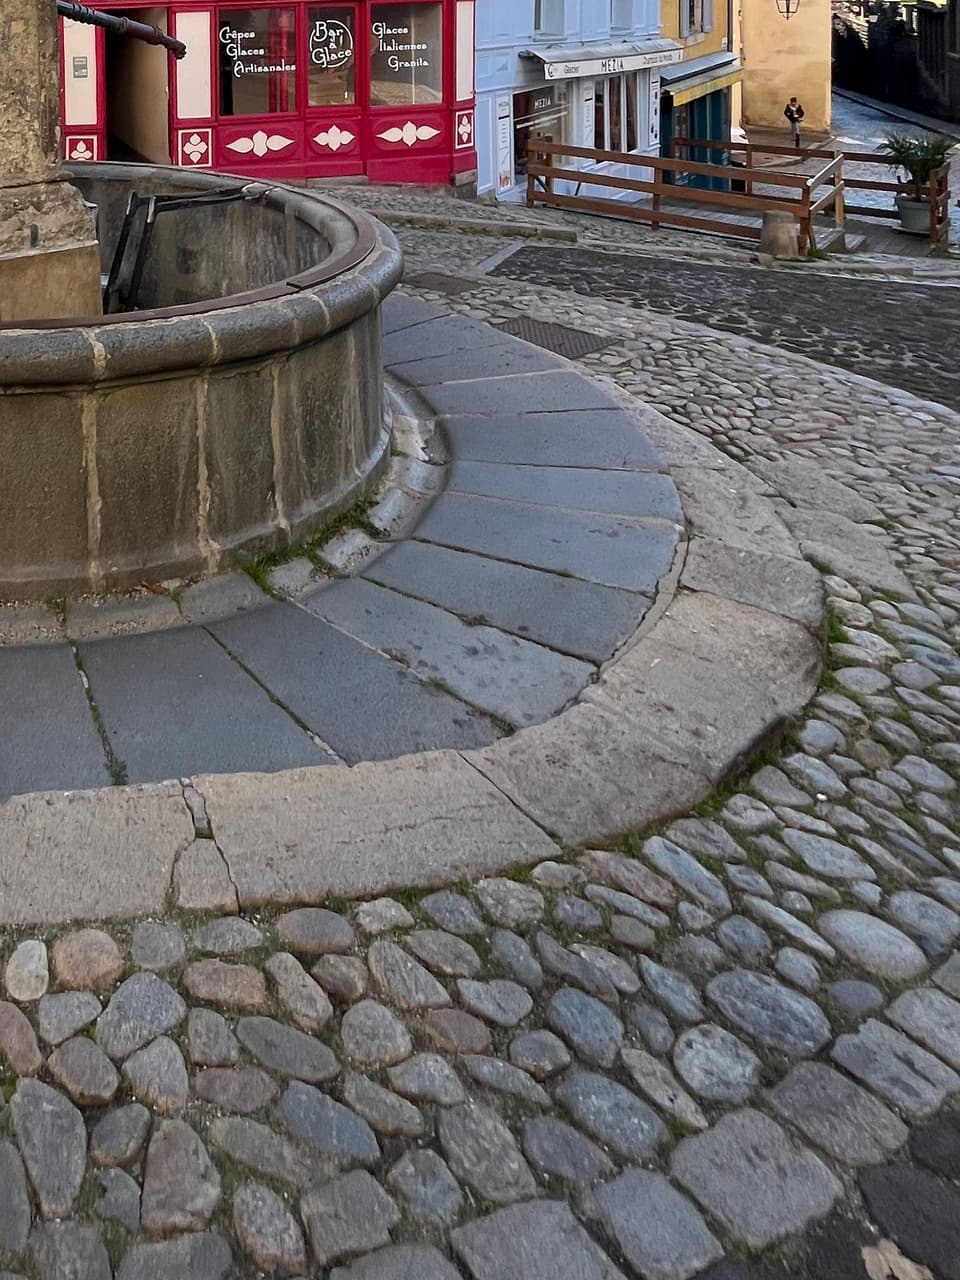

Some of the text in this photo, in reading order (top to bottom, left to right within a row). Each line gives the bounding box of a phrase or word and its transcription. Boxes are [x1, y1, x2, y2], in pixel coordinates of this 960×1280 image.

[219, 26, 255, 43] Crêpes
[313, 21, 344, 42] Bar
[372, 22, 408, 38] Glaces
[226, 43, 265, 60] Glaces
[379, 39, 427, 51] Italiennes
[312, 48, 352, 68] Glace
[388, 55, 430, 71] Granita
[601, 58, 625, 73] MEZIA
[234, 59, 296, 78] Artisanales
